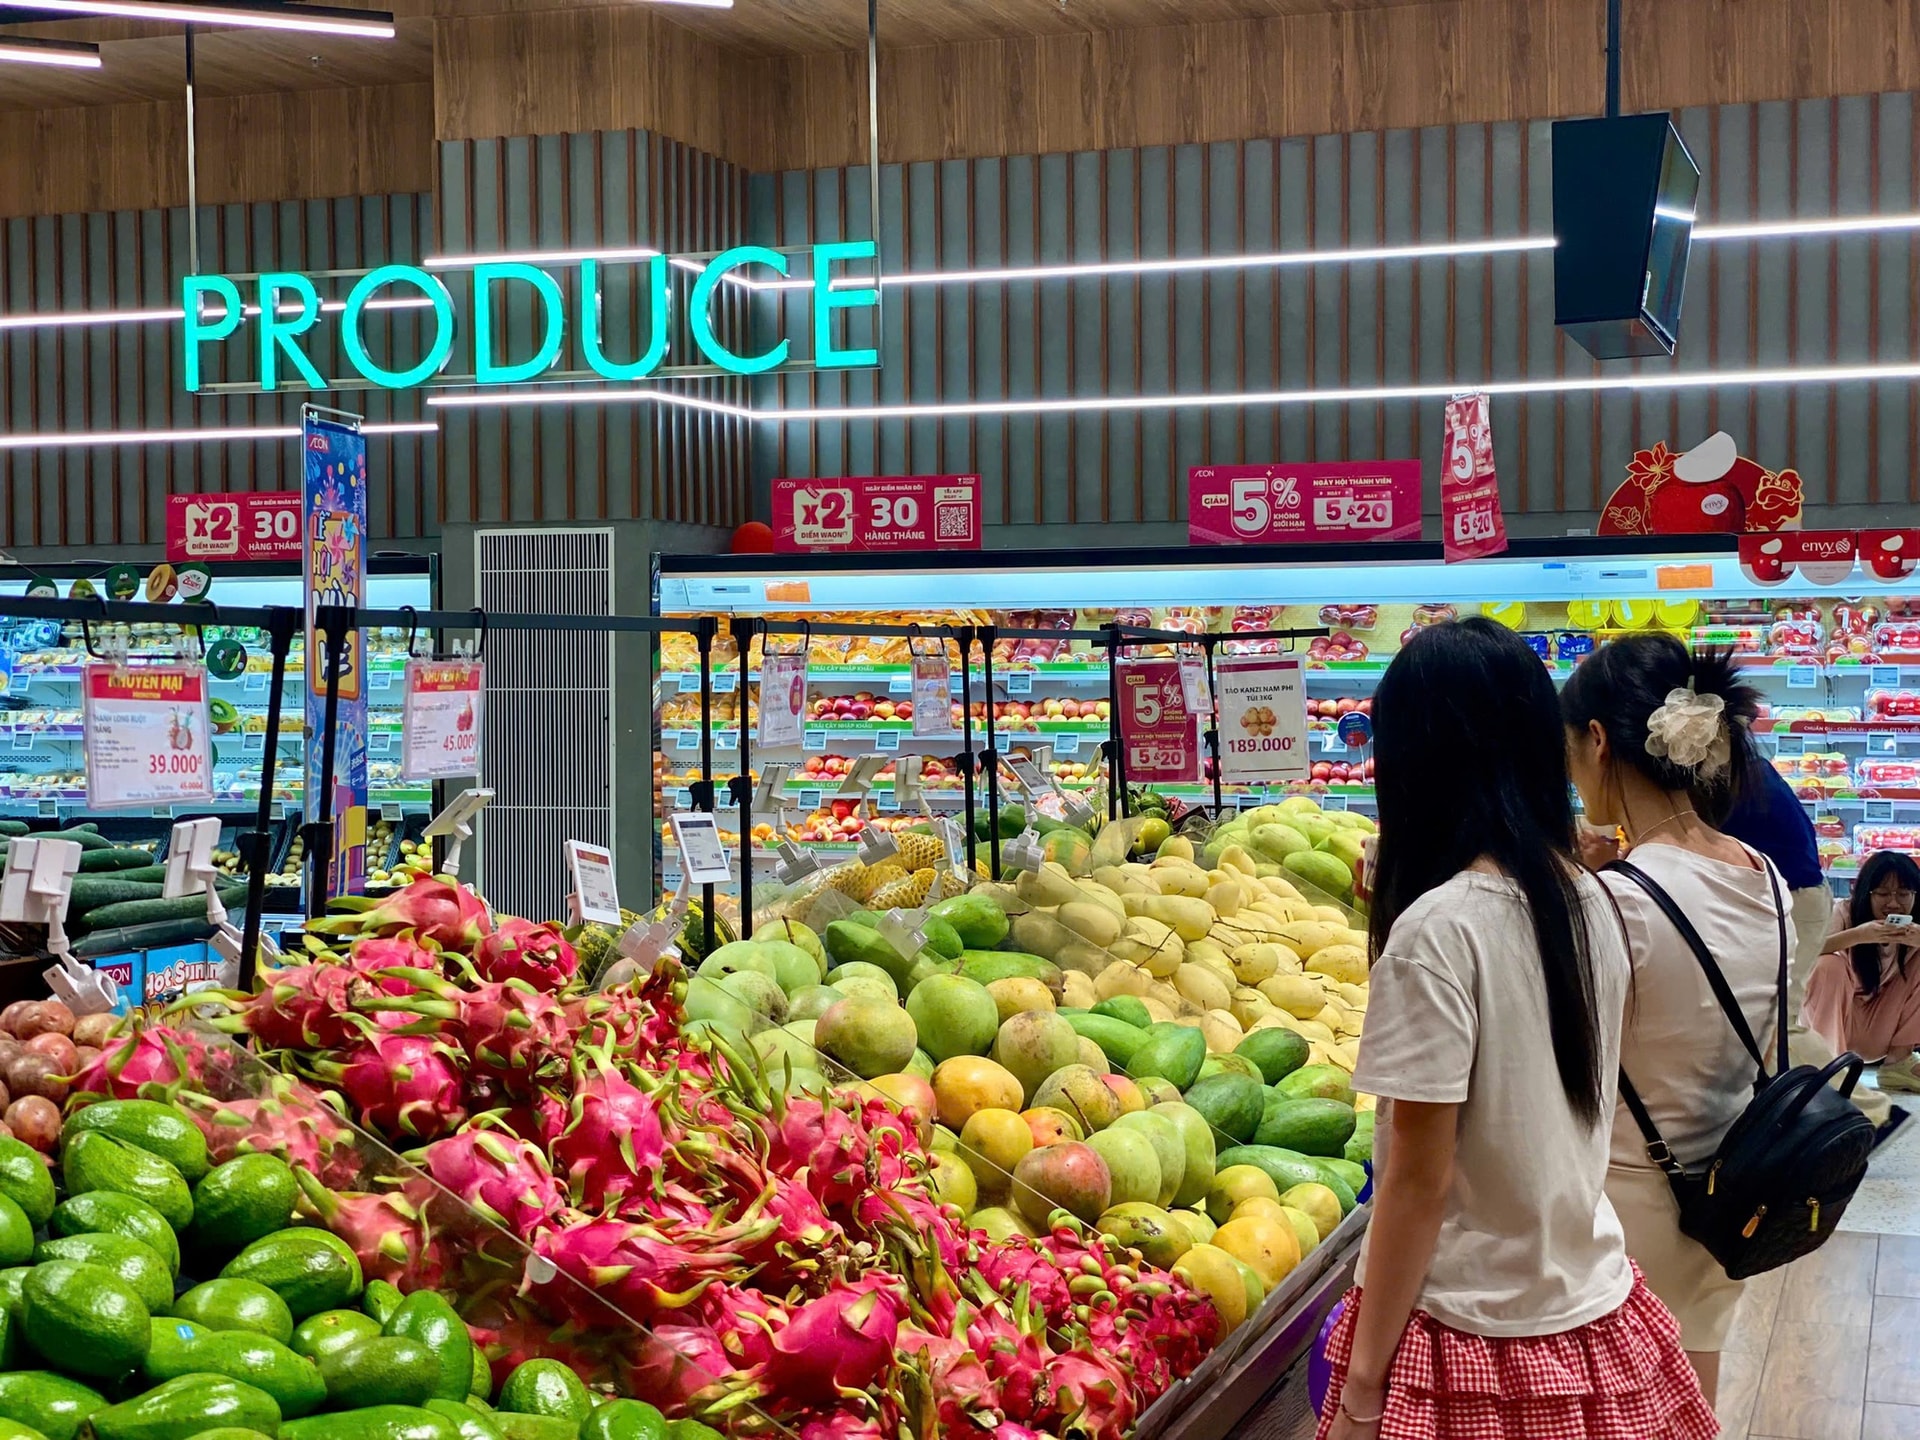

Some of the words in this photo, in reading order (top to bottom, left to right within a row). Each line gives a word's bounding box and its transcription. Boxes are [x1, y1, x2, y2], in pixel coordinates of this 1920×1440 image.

[183, 241, 880, 391] PRODUCE
[1313, 479, 1334, 487] NGÀY
[1335, 478, 1348, 487] HỘI
[1348, 477, 1374, 486] THÀNH
[1375, 476, 1393, 485] VIÊN
[1204, 496, 1228, 505] GIẢM
[801, 492, 846, 529] x2
[871, 496, 919, 528] 30
[1273, 512, 1300, 520] KHÔNG
[1326, 499, 1342, 521] 5
[1357, 502, 1388, 523] 20
[193, 507, 232, 540] x2
[254, 510, 297, 539] 30
[1289, 520, 1305, 528] HẠN
[1461, 513, 1470, 535] 5
[1477, 513, 1491, 534] 20
[865, 530, 891, 540] HÀNG
[893, 530, 925, 540] THÁNG
[249, 541, 272, 551] HÀNG
[273, 541, 302, 550] THÁNG
[1801, 541, 1836, 558] envy
[161, 676, 184, 694] MẠI
[1139, 749, 1150, 764] 5
[1161, 751, 1181, 765] 20
[146, 966, 173, 997] Hot
